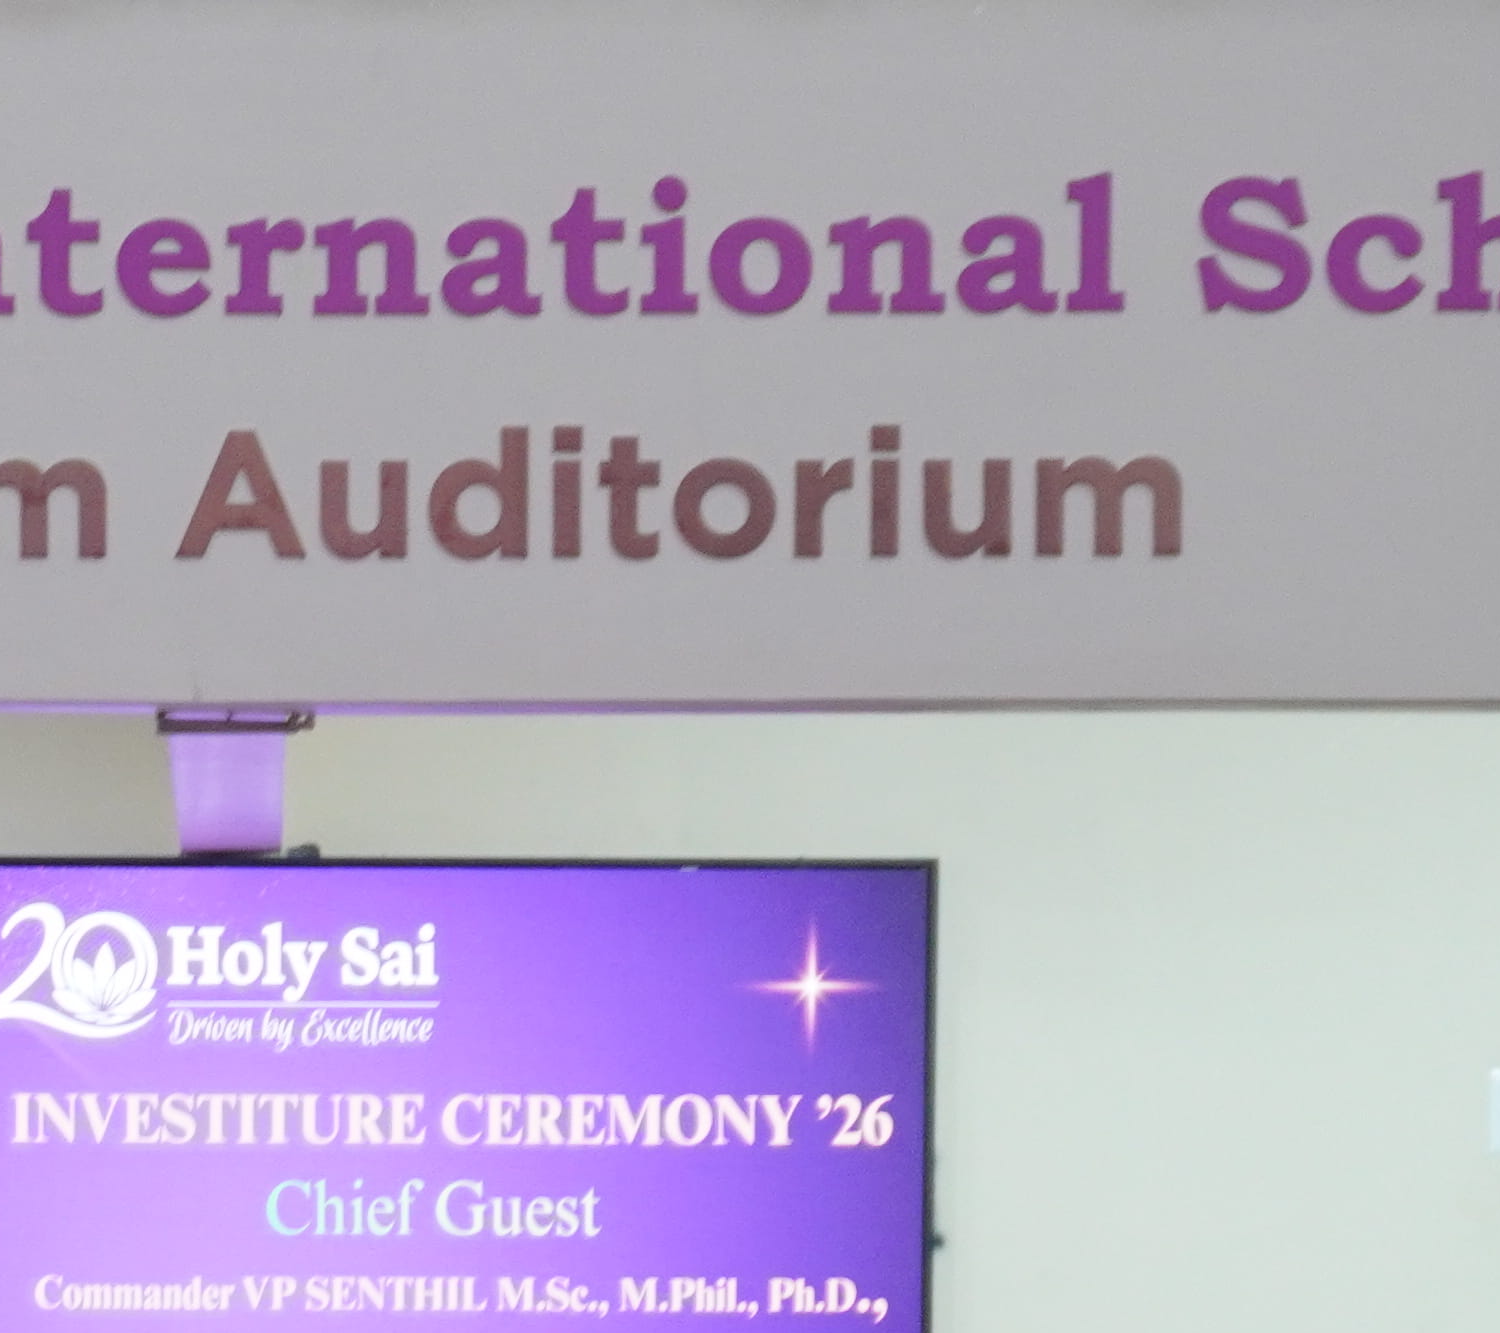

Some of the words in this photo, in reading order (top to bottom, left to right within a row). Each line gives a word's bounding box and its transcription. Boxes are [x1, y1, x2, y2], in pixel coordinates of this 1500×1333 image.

[174, 423, 1184, 565] Auditorium
[167, 921, 328, 1003] Holy
[341, 922, 440, 987] Sai
[167, 1008, 253, 1044] Driven
[261, 1009, 296, 1053] by
[302, 1008, 434, 1047] Excellence
[10, 1092, 428, 1146] INVESTITURE
[441, 1092, 803, 1147] CEREMONY
[815, 1092, 896, 1147] ’26
[265, 1177, 426, 1237] Chief
[435, 1178, 603, 1239] Guest
[34, 1273, 236, 1313] Commander
[243, 1275, 298, 1312] VP
[304, 1275, 488, 1313] SENTHIL
[497, 1275, 610, 1318] M.Sc.,
[619, 1275, 760, 1319] M.Phil.,
[766, 1276, 889, 1325] Ph.D.,
